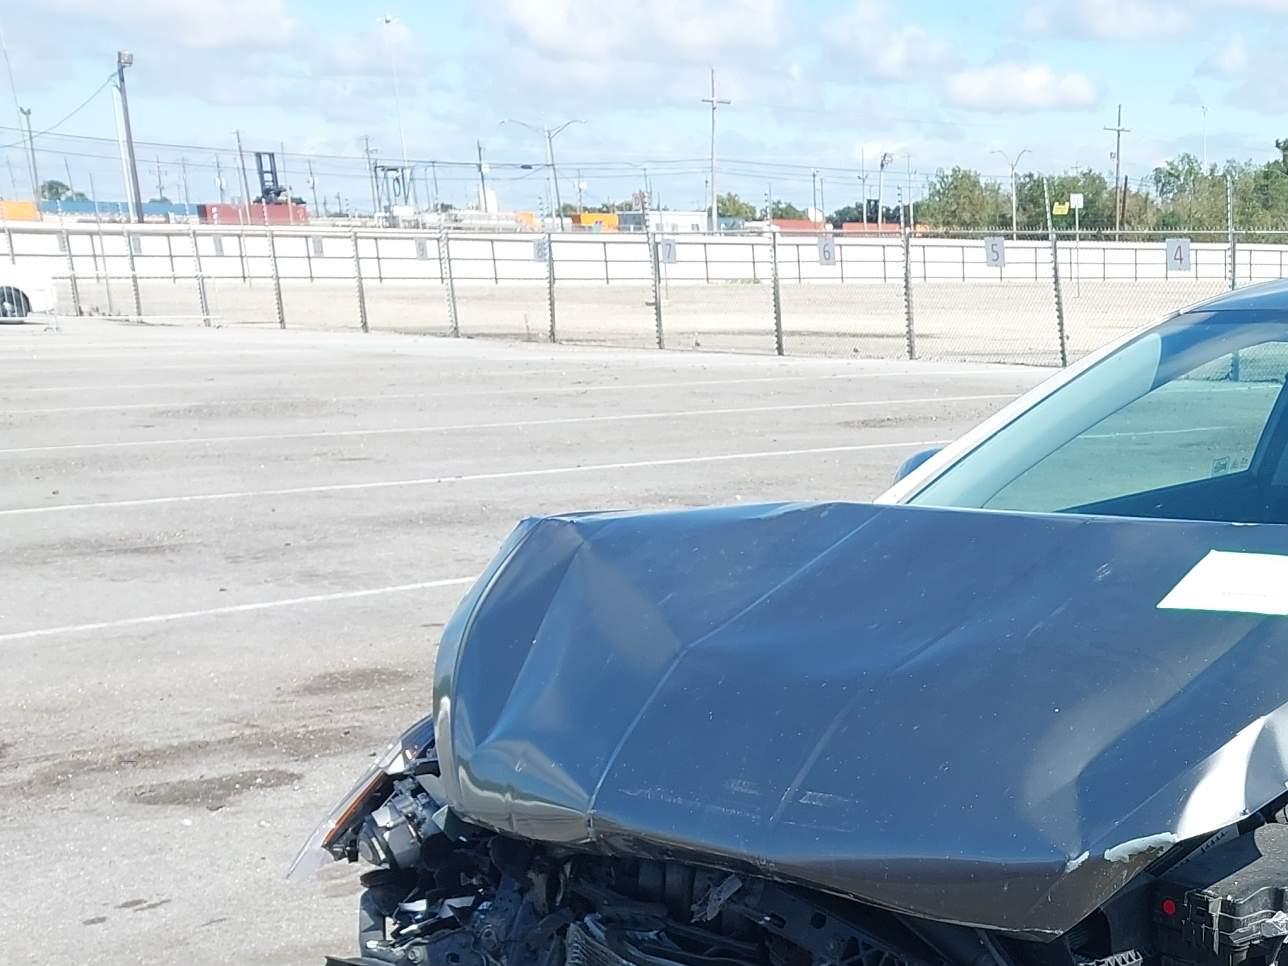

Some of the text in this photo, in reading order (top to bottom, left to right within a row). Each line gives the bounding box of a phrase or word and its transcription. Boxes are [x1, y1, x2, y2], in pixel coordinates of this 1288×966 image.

[664, 242, 672, 258] 7
[823, 242, 831, 261] 6
[991, 243, 1000, 262] 5
[1173, 245, 1184, 264] 4
